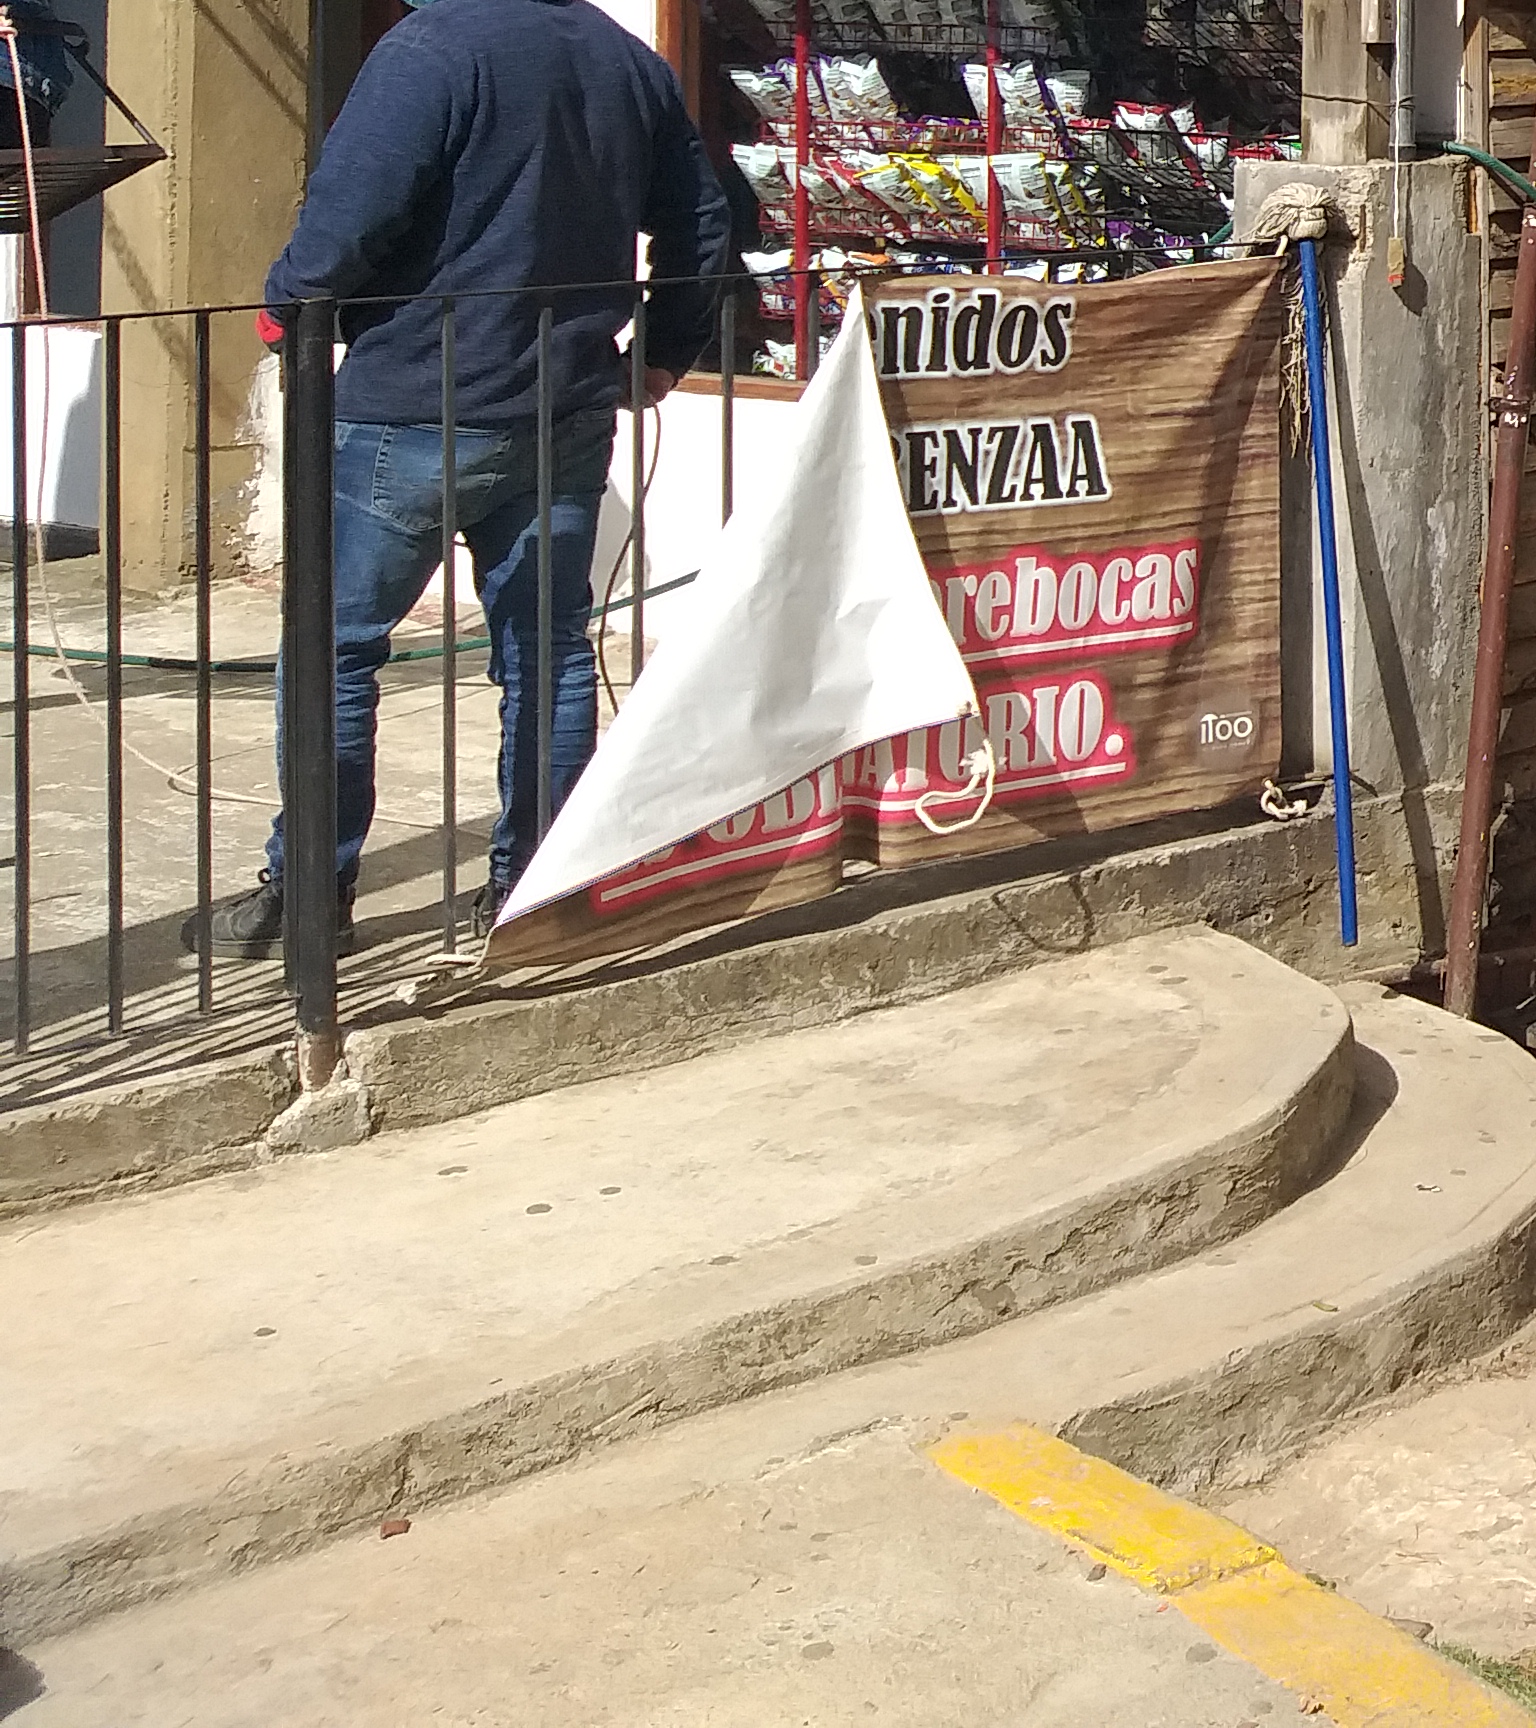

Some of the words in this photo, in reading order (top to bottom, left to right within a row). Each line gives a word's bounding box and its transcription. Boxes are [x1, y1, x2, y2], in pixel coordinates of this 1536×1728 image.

[868, 290, 1073, 375] nidos
[890, 419, 1109, 512] ENZAA
[930, 546, 1198, 646] rebocas
